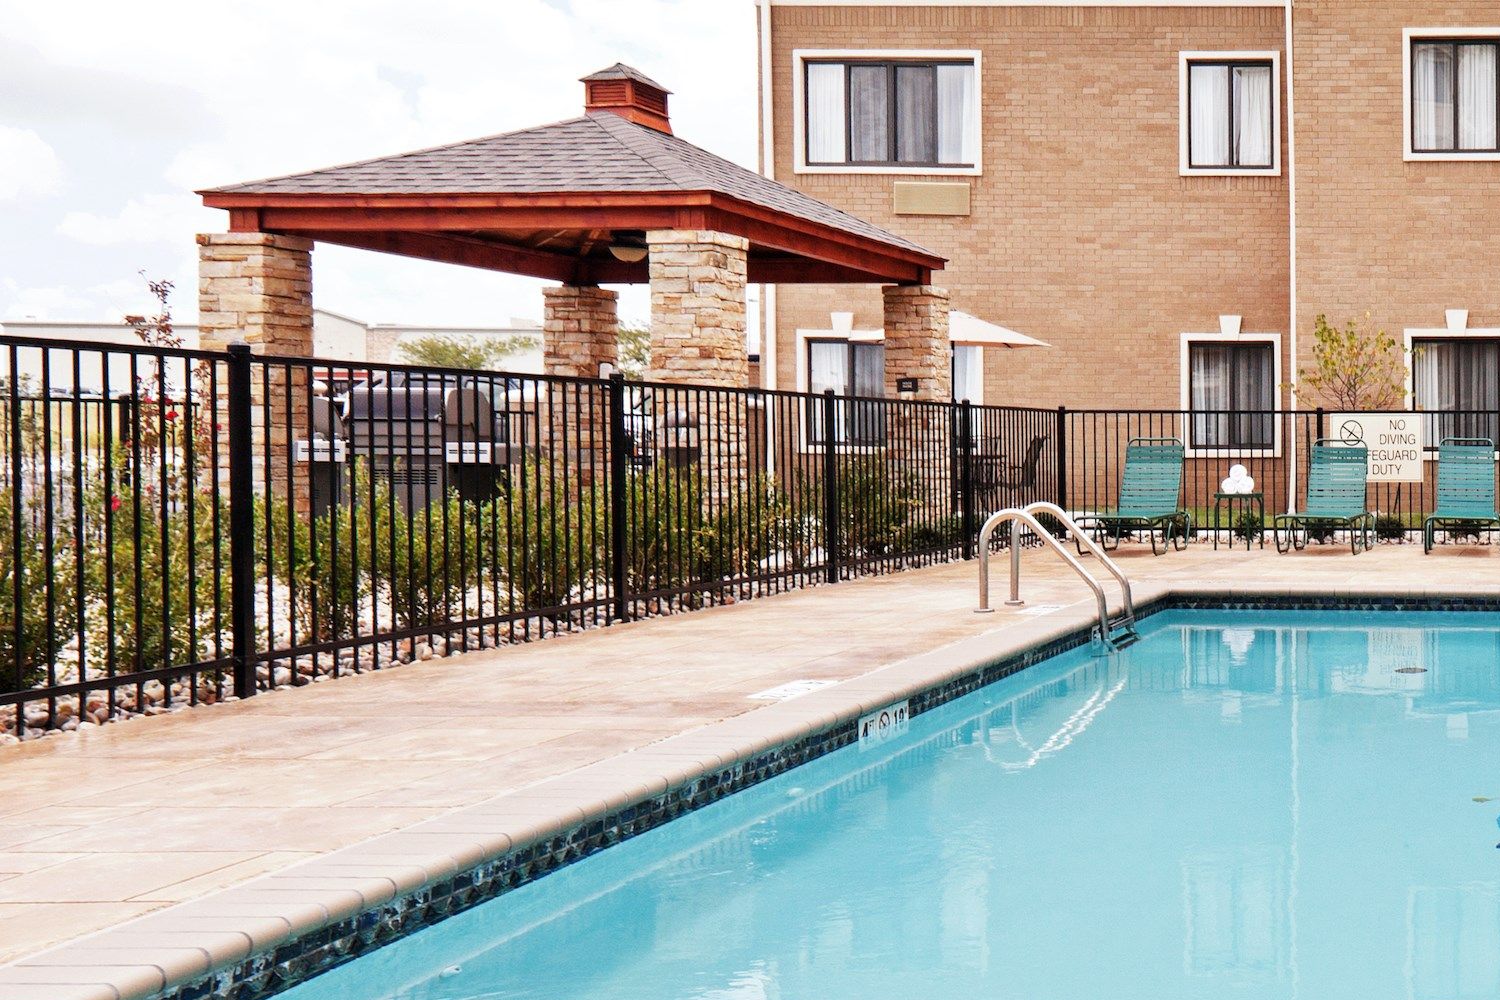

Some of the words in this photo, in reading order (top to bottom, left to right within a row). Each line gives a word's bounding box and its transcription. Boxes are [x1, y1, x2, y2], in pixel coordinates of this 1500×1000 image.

[1389, 419, 1406, 431] NO
[1379, 433, 1416, 445] DIVING
[1372, 464, 1402, 475] DUTY
